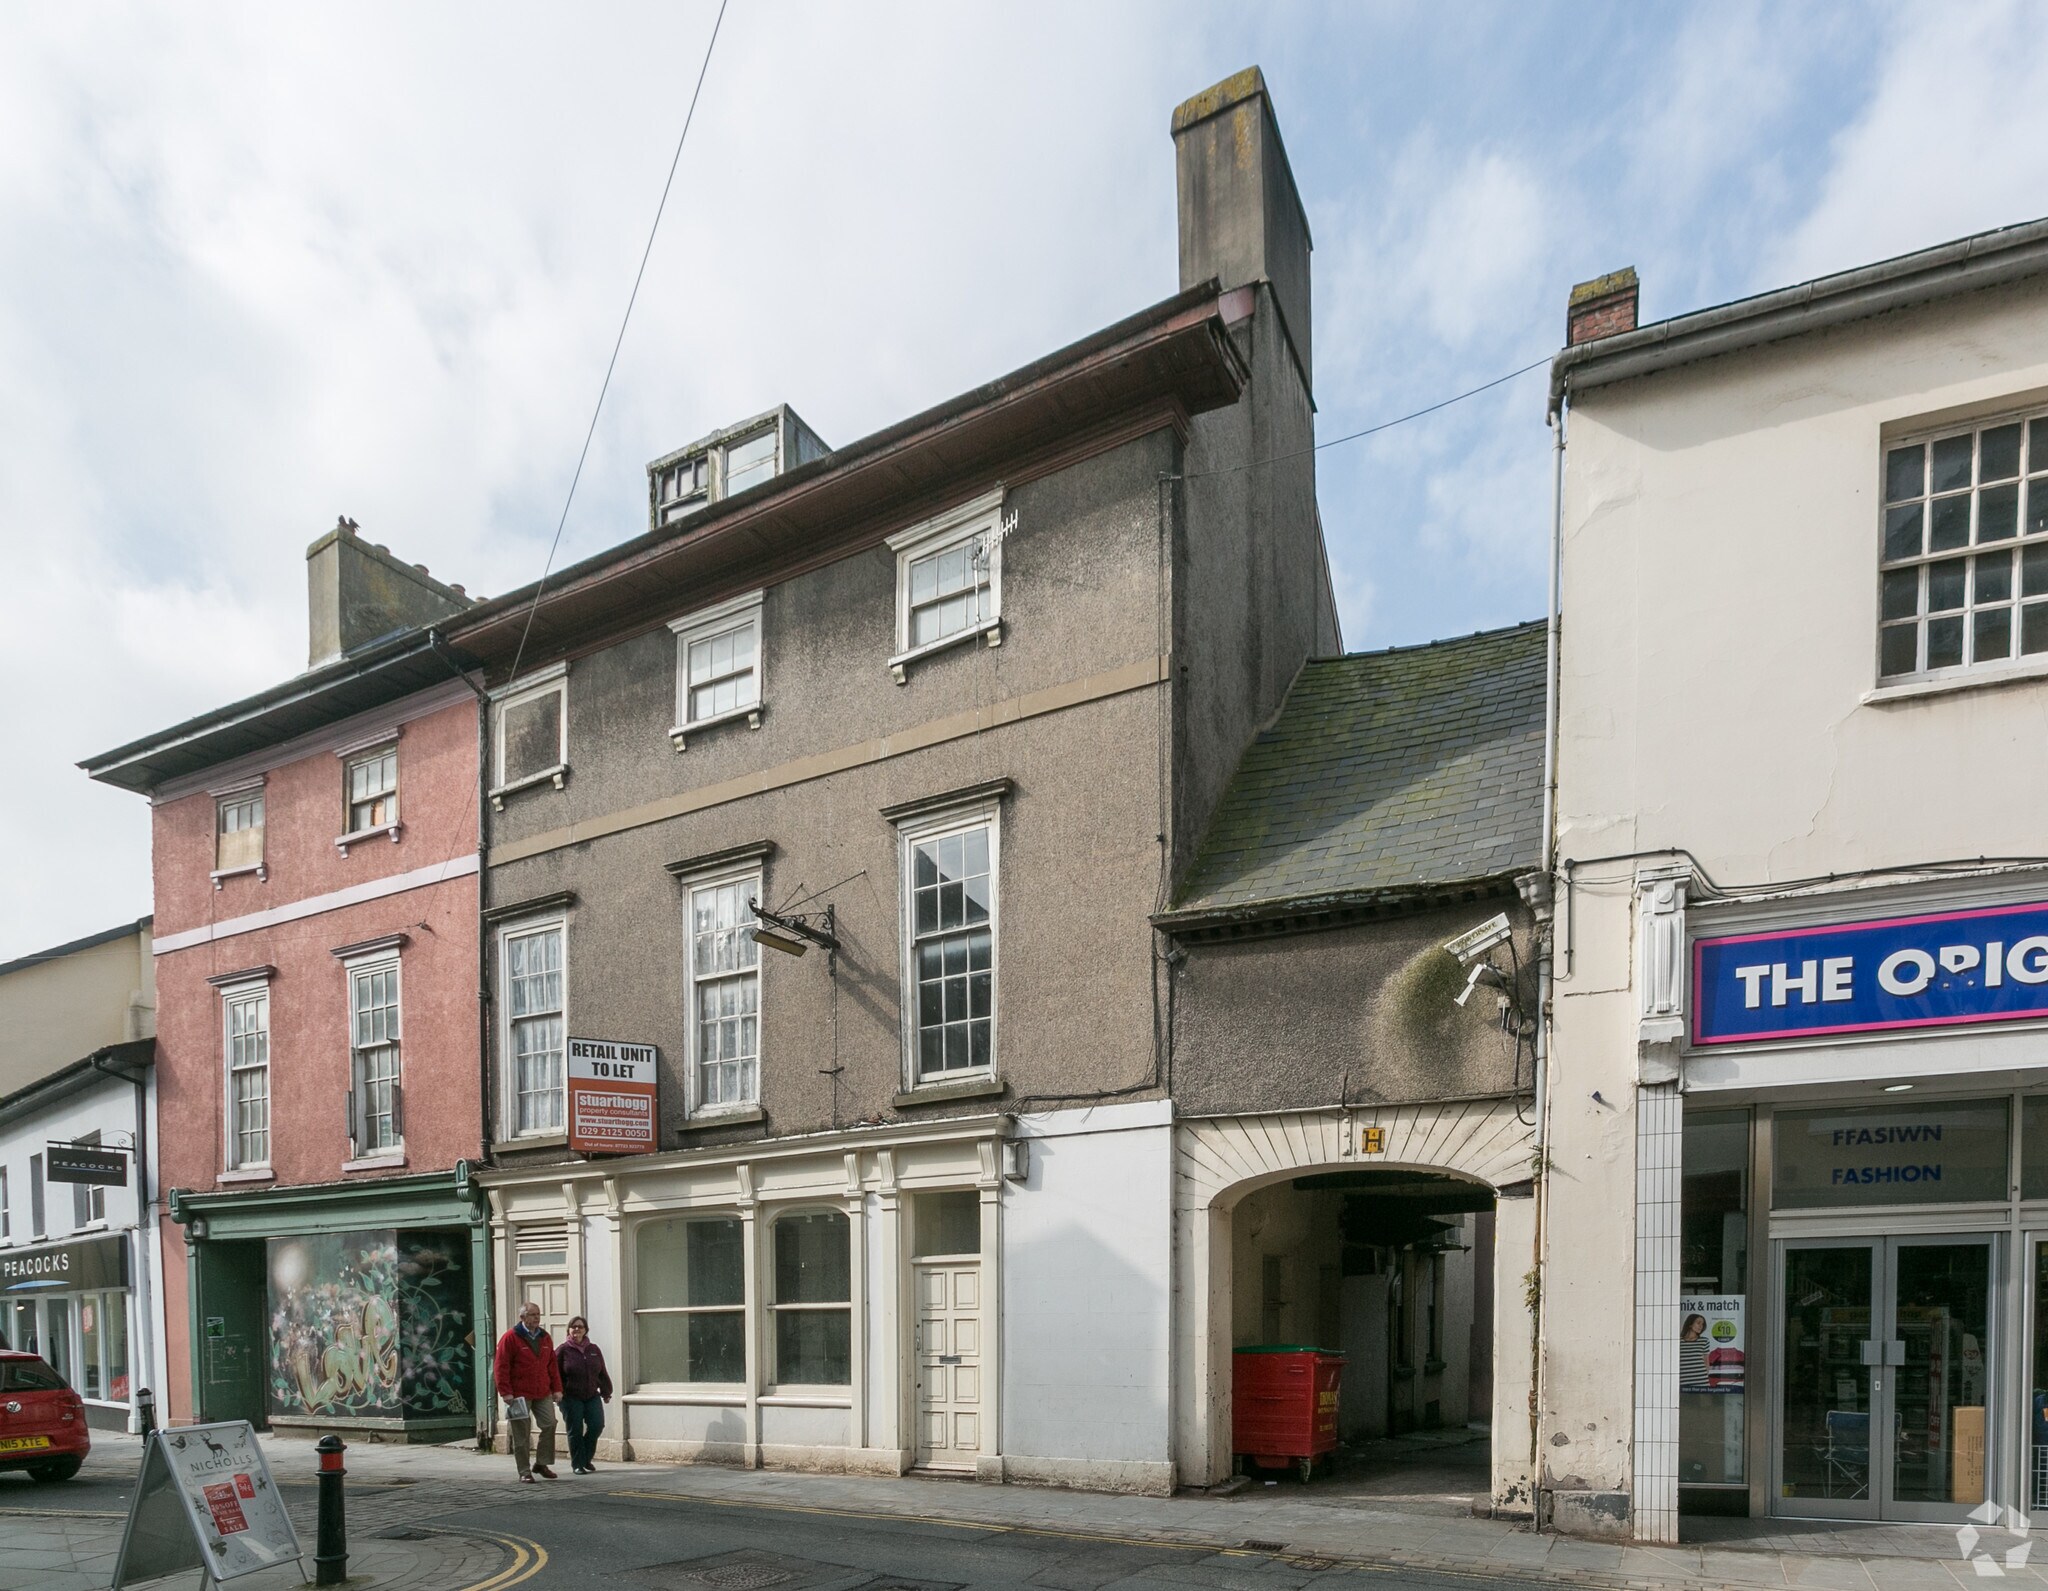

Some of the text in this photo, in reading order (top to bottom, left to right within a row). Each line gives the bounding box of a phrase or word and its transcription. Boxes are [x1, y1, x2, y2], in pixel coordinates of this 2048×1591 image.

[1735, 956, 1853, 1010] THE
[572, 1042, 652, 1063] RETAIL UNIT
[591, 1062, 634, 1079] TO LET
[579, 1095, 648, 1110] stuarthogg
[579, 1107, 648, 1117] property consultants
[580, 1117, 649, 1127] www.stuarthogg.com
[581, 1127, 647, 1138] 029 2125 0050
[1833, 1124, 1942, 1146] FFASIWN
[52, 1160, 123, 1171] PEACOCKS
[1832, 1164, 1942, 1186] FASHION
[4, 1252, 69, 1277] PEACOCKS
[1697, 1301, 1705, 1311] &
[1706, 1299, 1740, 1311] match
[21, 1437, 43, 1447] XTE
[190, 1454, 253, 1472] NICHOLLS
